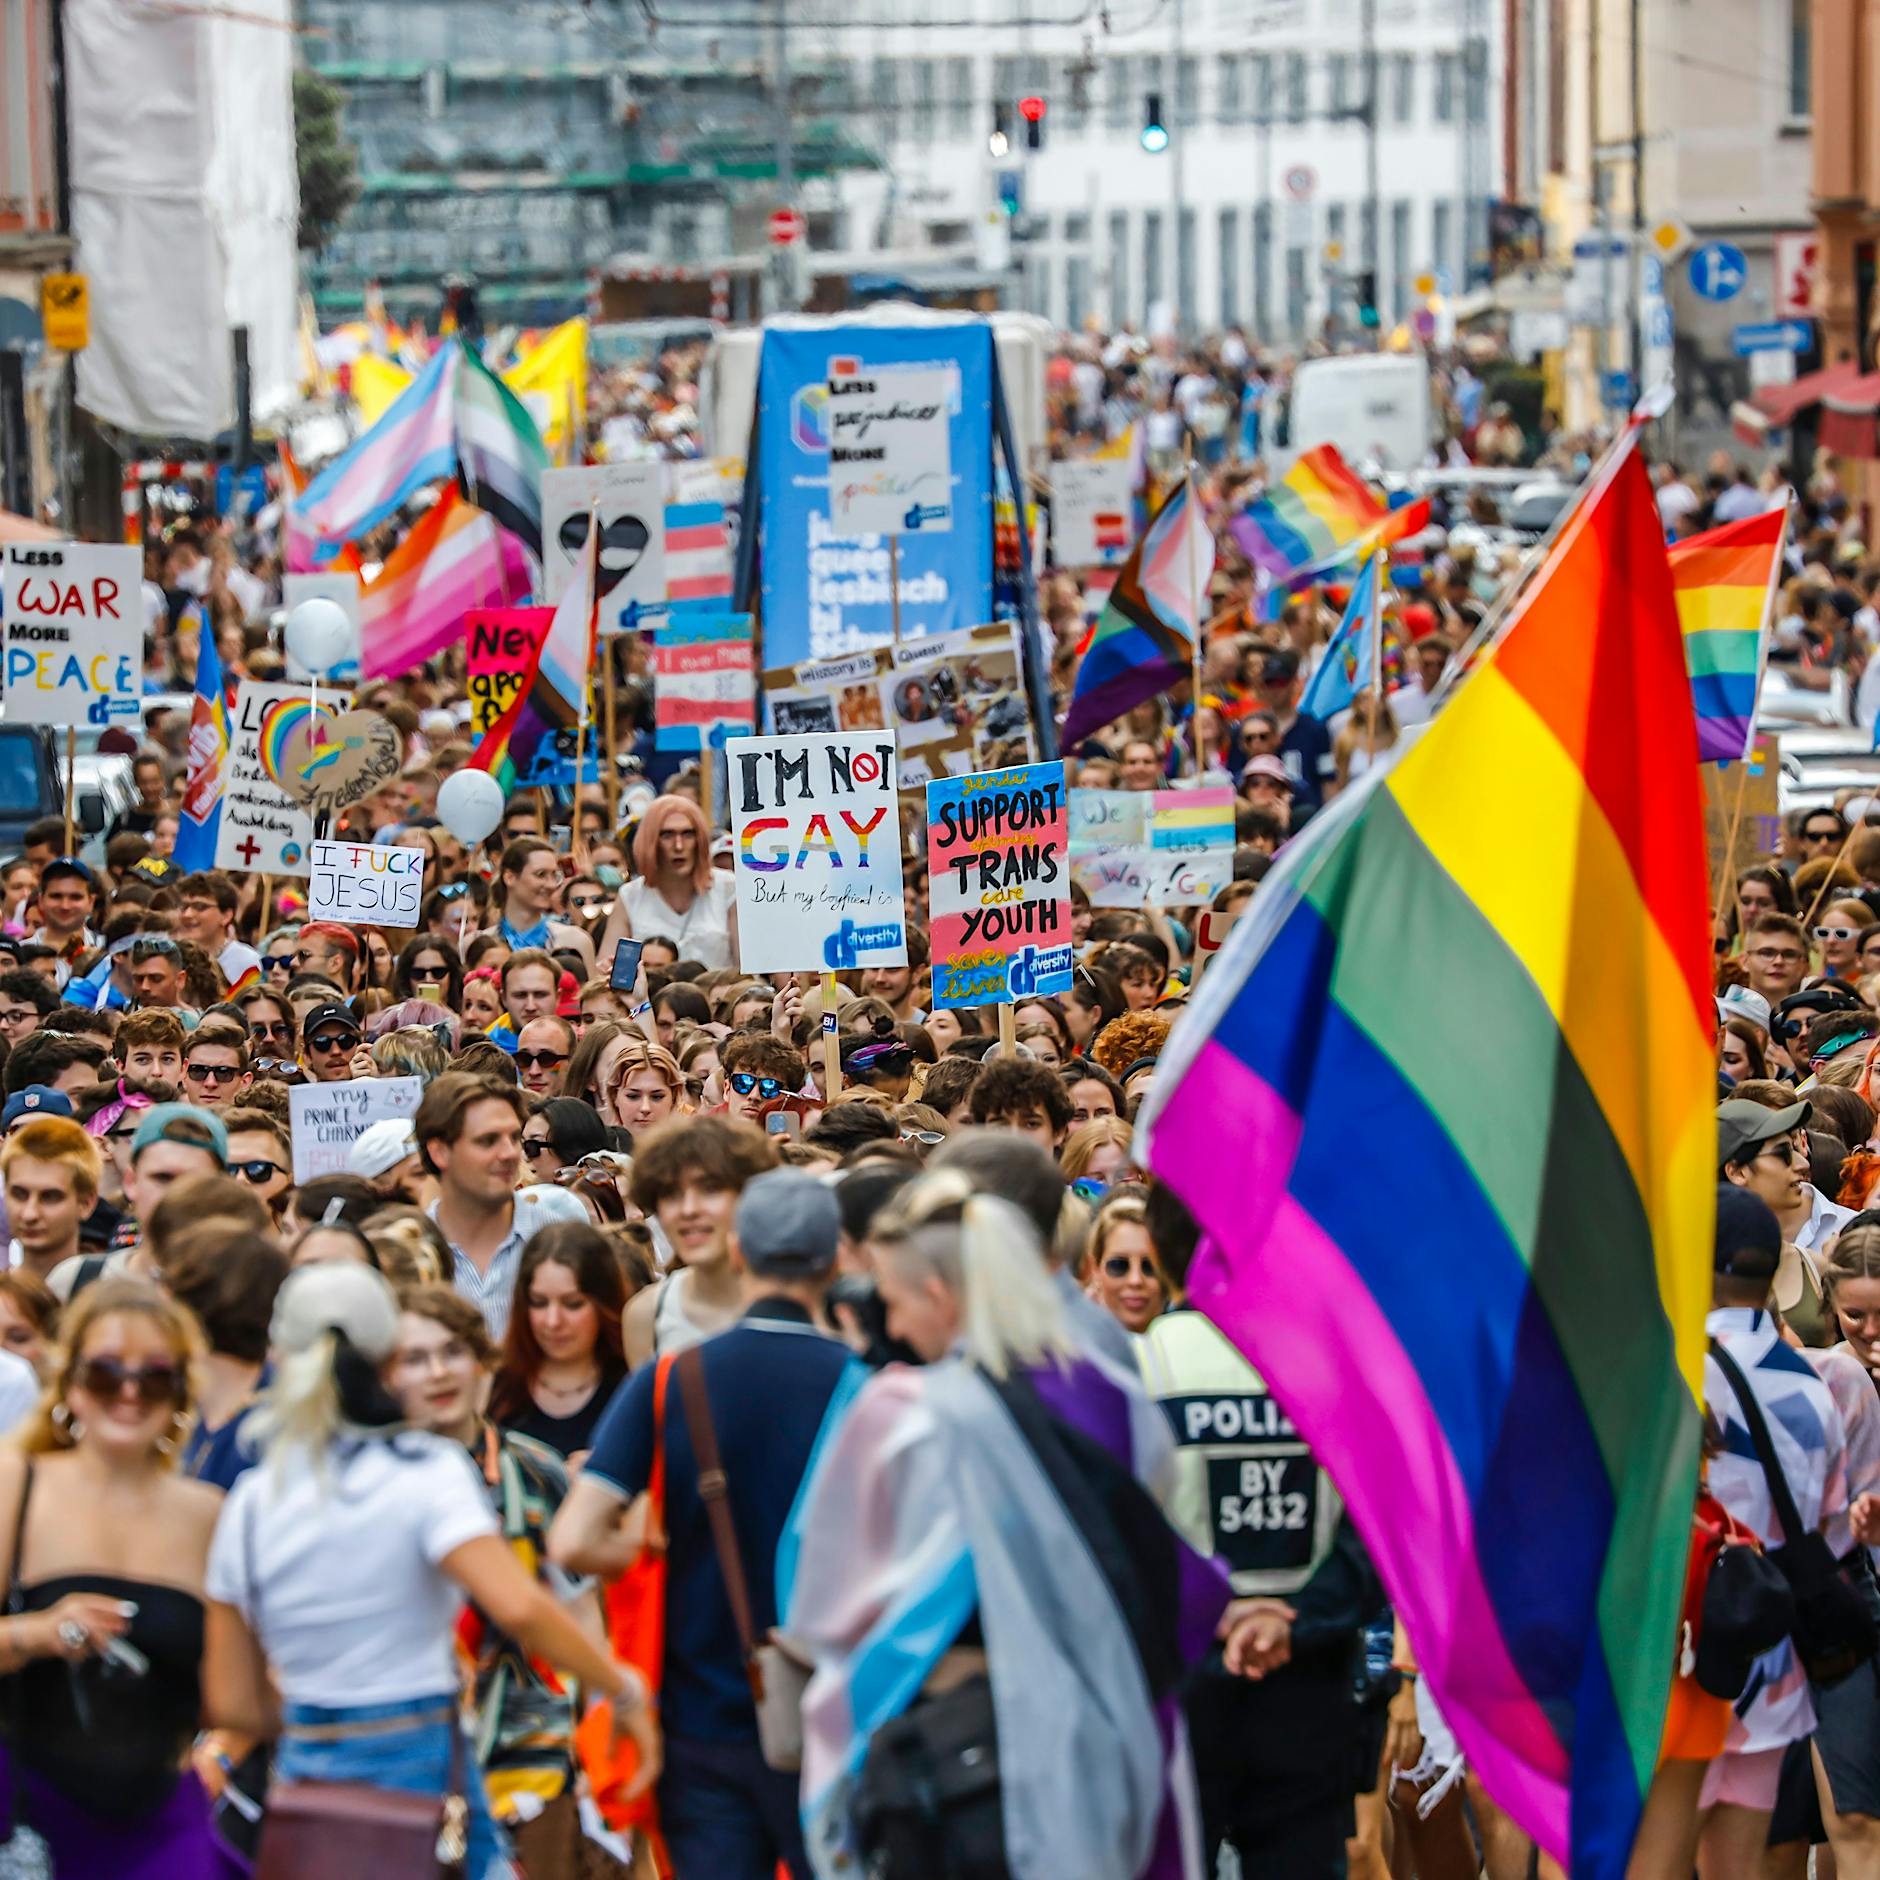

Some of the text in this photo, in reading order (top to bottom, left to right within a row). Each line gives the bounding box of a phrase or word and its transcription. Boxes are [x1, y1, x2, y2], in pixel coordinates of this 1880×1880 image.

[17, 576, 121, 620] WAR
[8, 647, 134, 693] PEACE
[737, 748, 814, 812] I'M
[936, 782, 1060, 848] SUPPORT
[740, 806, 888, 872] GAY
[314, 845, 421, 875] I FUCK
[949, 842, 1058, 895] TRANS
[315, 873, 417, 912] JESUS
[751, 877, 788, 903] But
[794, 890, 816, 913] my
[819, 883, 873, 911] boyfriend
[981, 887, 1025, 905] care
[847, 928, 898, 947] diversity
[959, 898, 1058, 946] YOUTH
[1029, 950, 1071, 973] diversity
[823, 1016, 834, 1027] BI
[304, 1106, 350, 1126] PRINCE
[332, 1088, 369, 1116] my
[317, 1123, 374, 1143] CHARM
[1240, 1459, 1289, 1498] BY
[1219, 1492, 1308, 1534] 5432
